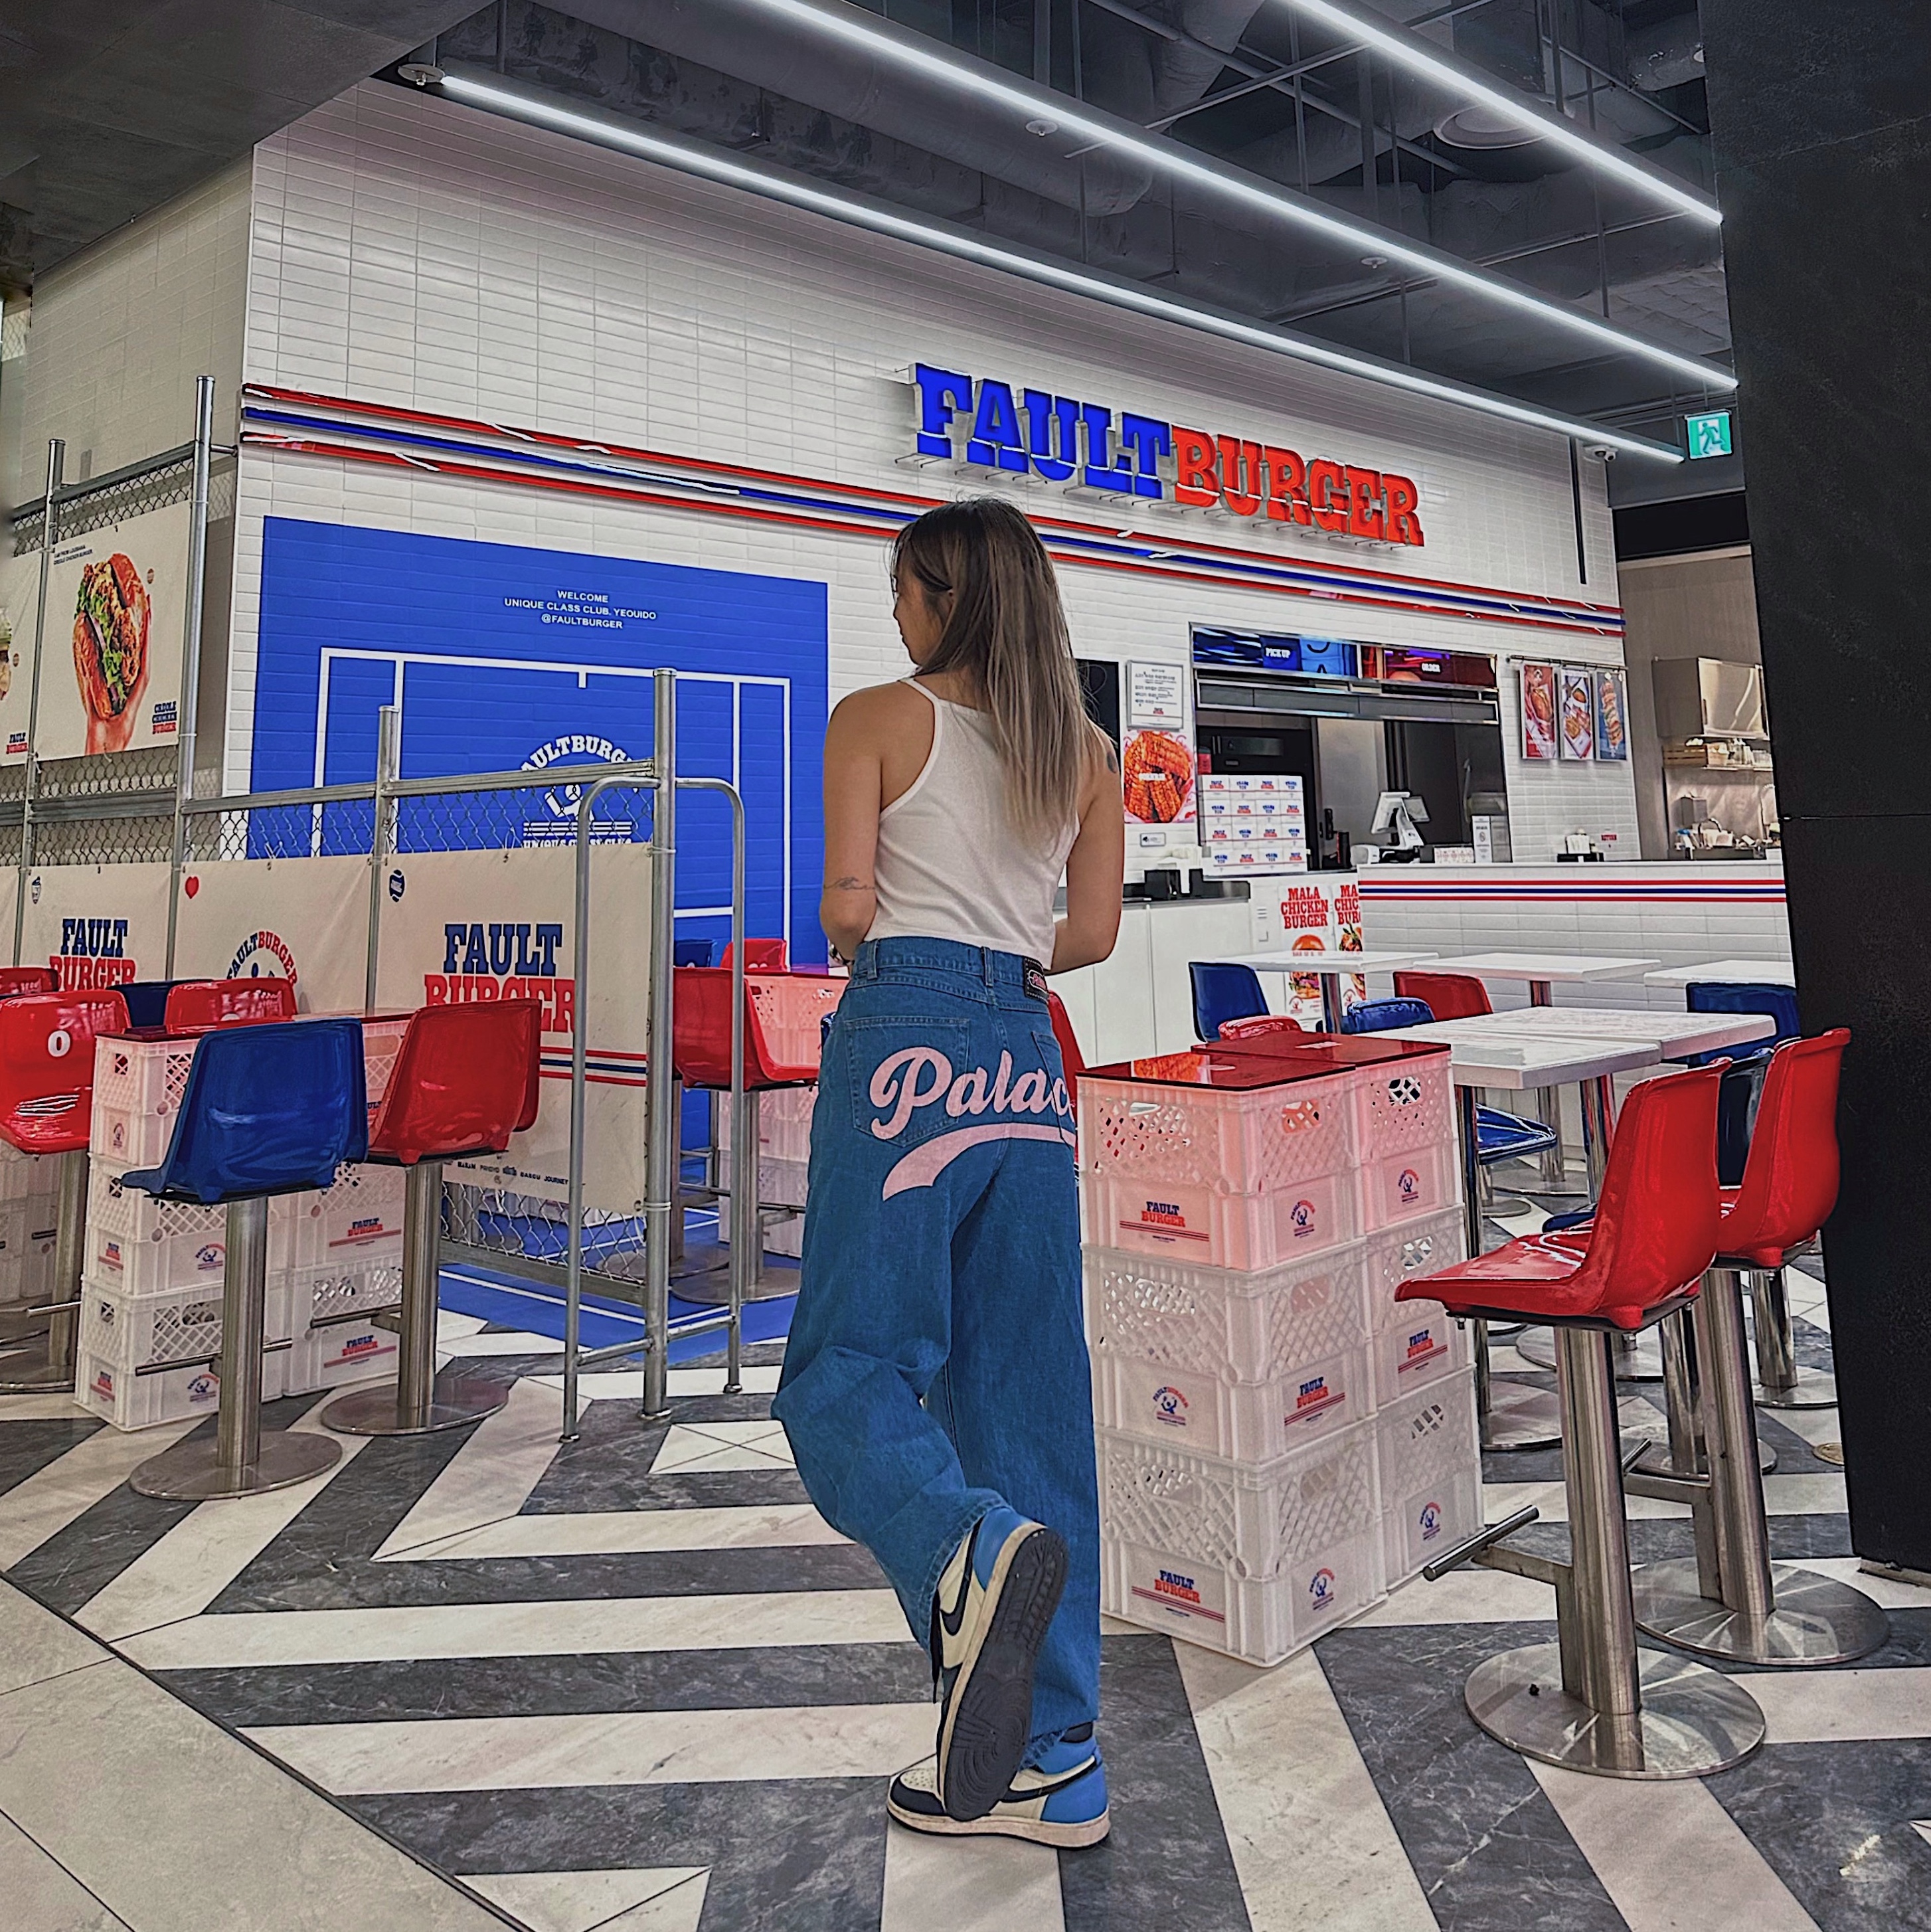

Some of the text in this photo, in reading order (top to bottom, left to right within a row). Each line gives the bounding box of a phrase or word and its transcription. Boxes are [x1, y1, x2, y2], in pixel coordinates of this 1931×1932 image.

[557, 590, 608, 603] WELCOME
[504, 598, 544, 609] UNIQUE
[546, 602, 580, 613] CLASS
[614, 608, 657, 620] YEOUIDO
[541, 613, 623, 629] @FAULTBURGER
[1288, 887, 1320, 901] MALA
[1280, 899, 1328, 915] CHICKEN
[1284, 913, 1328, 929] BURGER
[1337, 911, 1361, 924] BUR
[60, 919, 128, 958] FAULT
[443, 923, 562, 976] FAULT
[869, 1047, 1074, 1140] Palac
[1146, 1201, 1179, 1216] FAULT
[1141, 1210, 1185, 1228] BURGER
[1159, 1570, 1194, 1590] FAULT
[1154, 1579, 1201, 1603] BURGER
